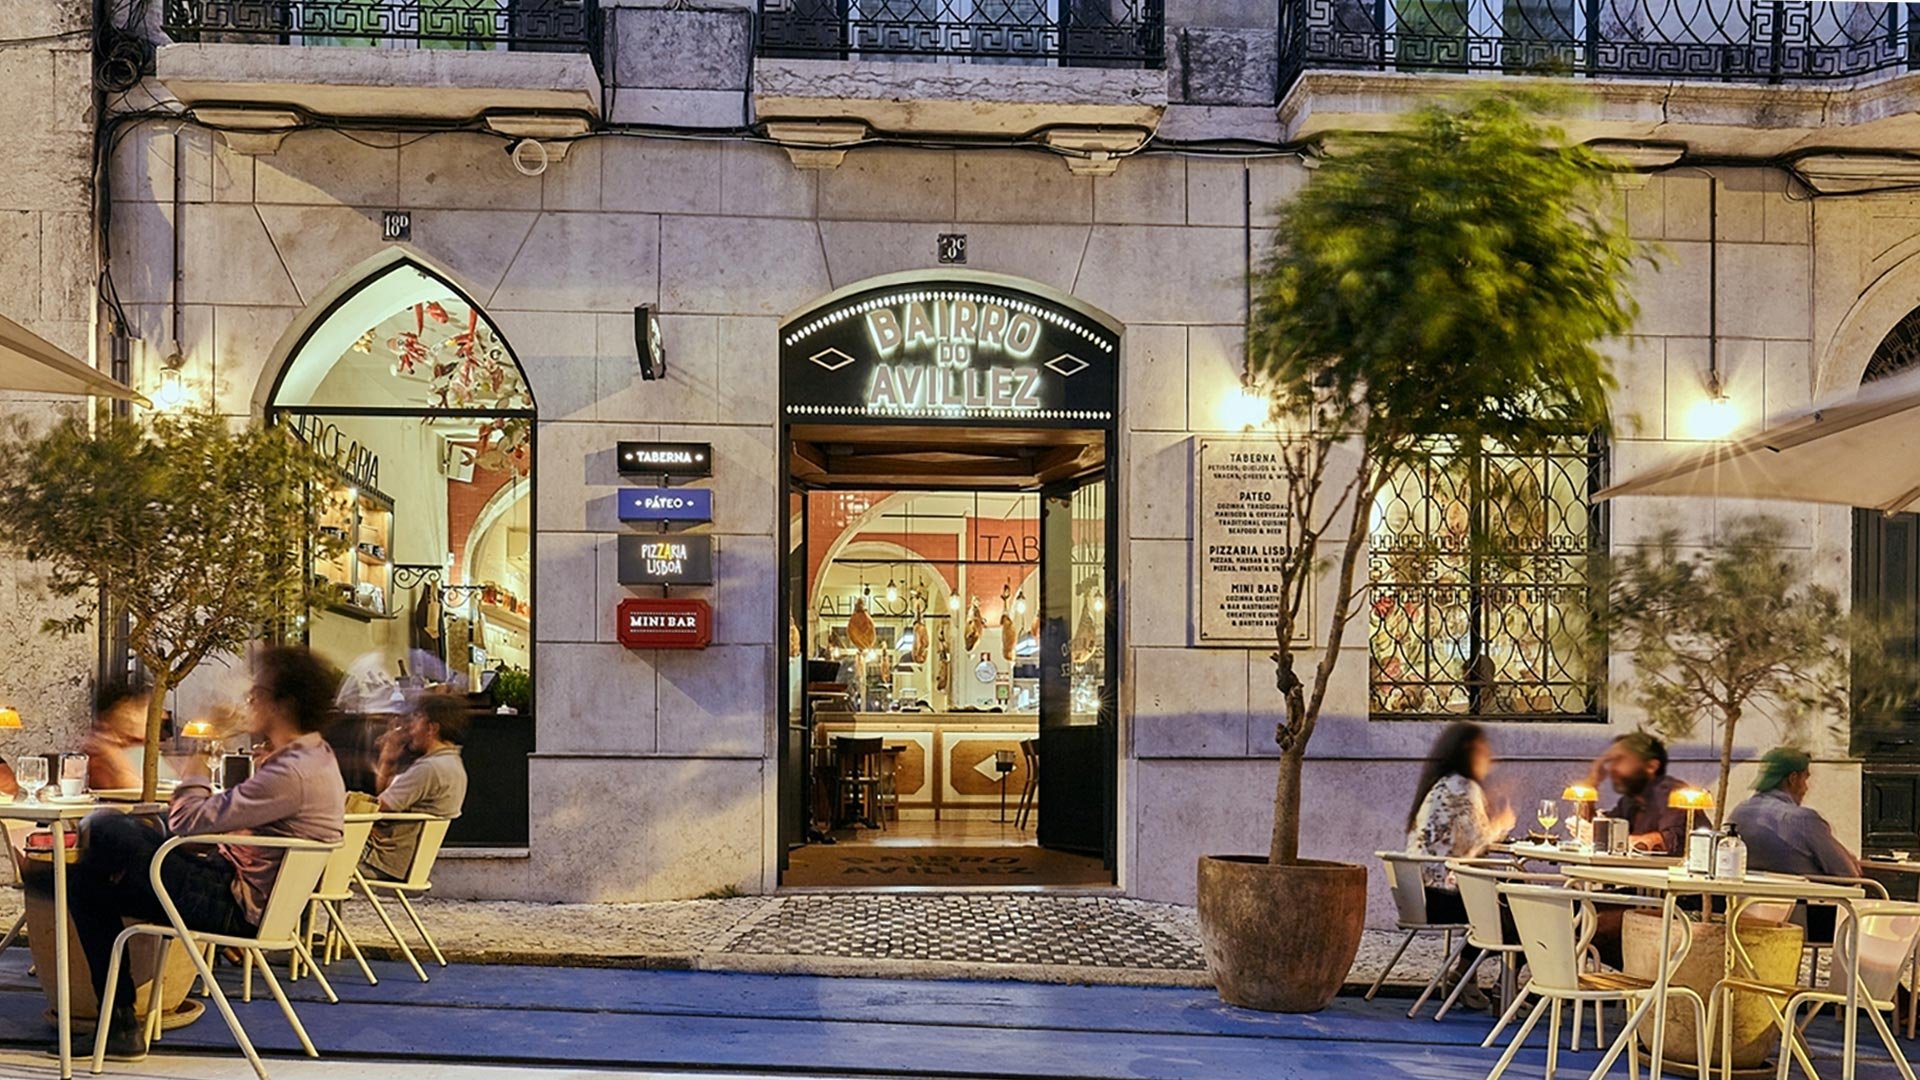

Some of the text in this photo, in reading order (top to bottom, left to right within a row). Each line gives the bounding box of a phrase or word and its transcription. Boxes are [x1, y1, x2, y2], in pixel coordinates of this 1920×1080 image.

[385, 215, 409, 237] 18D
[867, 300, 1040, 357] BAIRRO
[938, 339, 970, 366] DO
[868, 363, 1040, 408] AVILLEZ
[636, 451, 692, 463] TABERNA
[1230, 453, 1276, 463] TABERNA
[645, 495, 683, 508] PÁTEO
[641, 543, 688, 560] PIZZARIA
[1209, 545, 1299, 555] PIZZARIA LISBA
[647, 559, 683, 575] LISBOA
[1231, 584, 1279, 593] MINI BAR
[630, 616, 696, 627] MINI BAR
